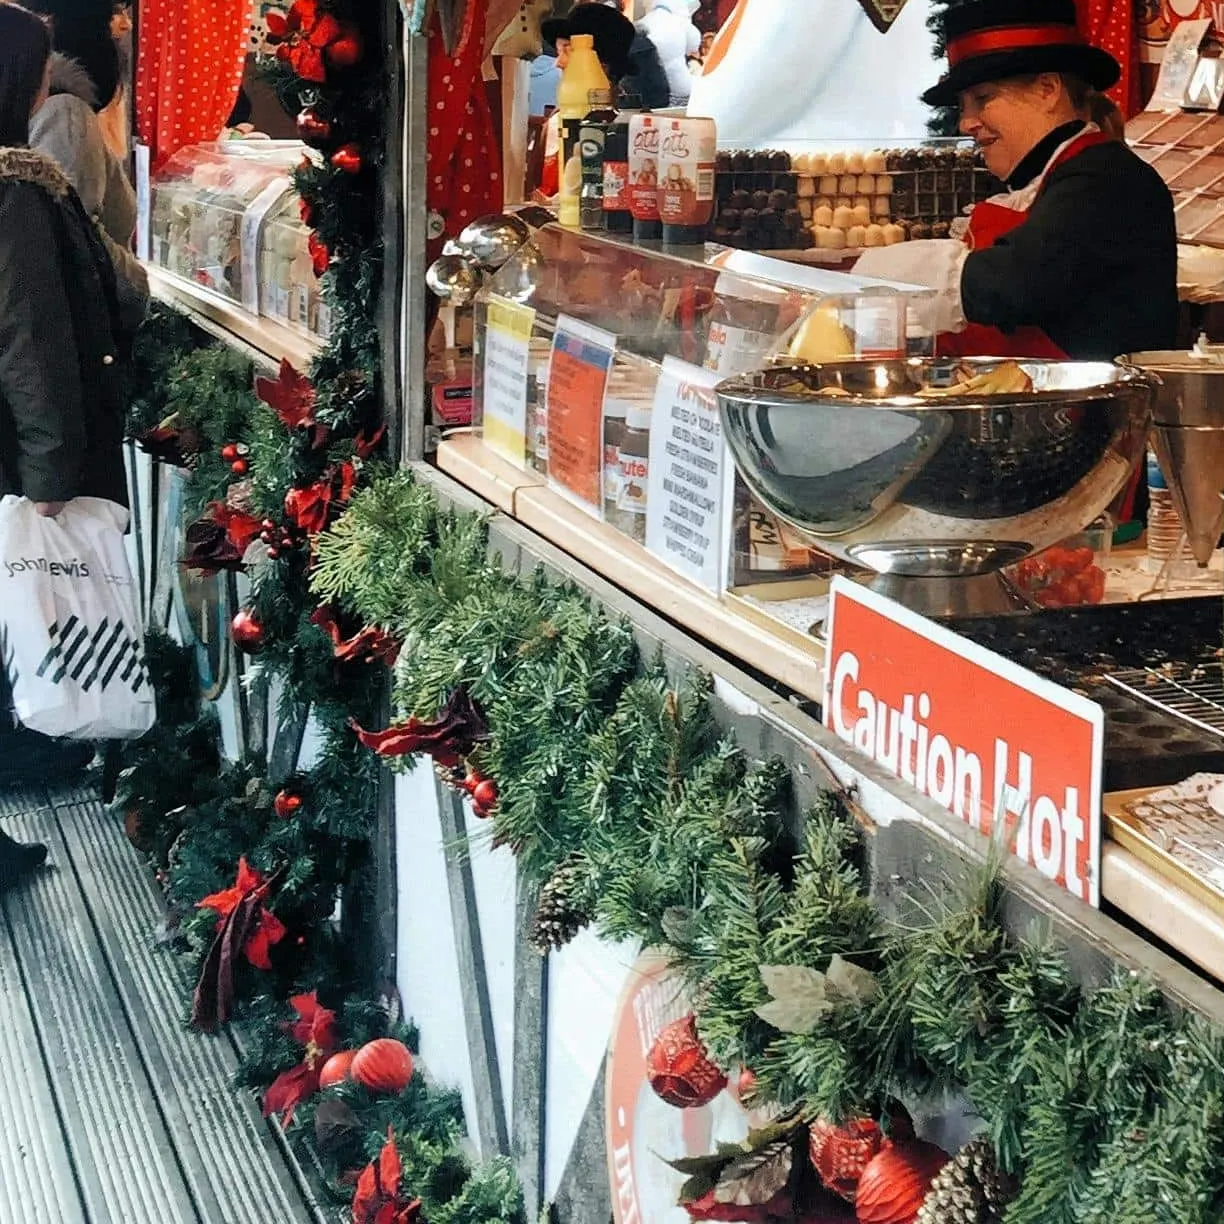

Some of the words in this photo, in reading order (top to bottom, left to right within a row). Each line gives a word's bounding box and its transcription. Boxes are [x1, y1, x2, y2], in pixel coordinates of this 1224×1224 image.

[49, 557, 90, 577] ewis
[832, 651, 982, 828] Caution
[992, 737, 1085, 900] Hot
